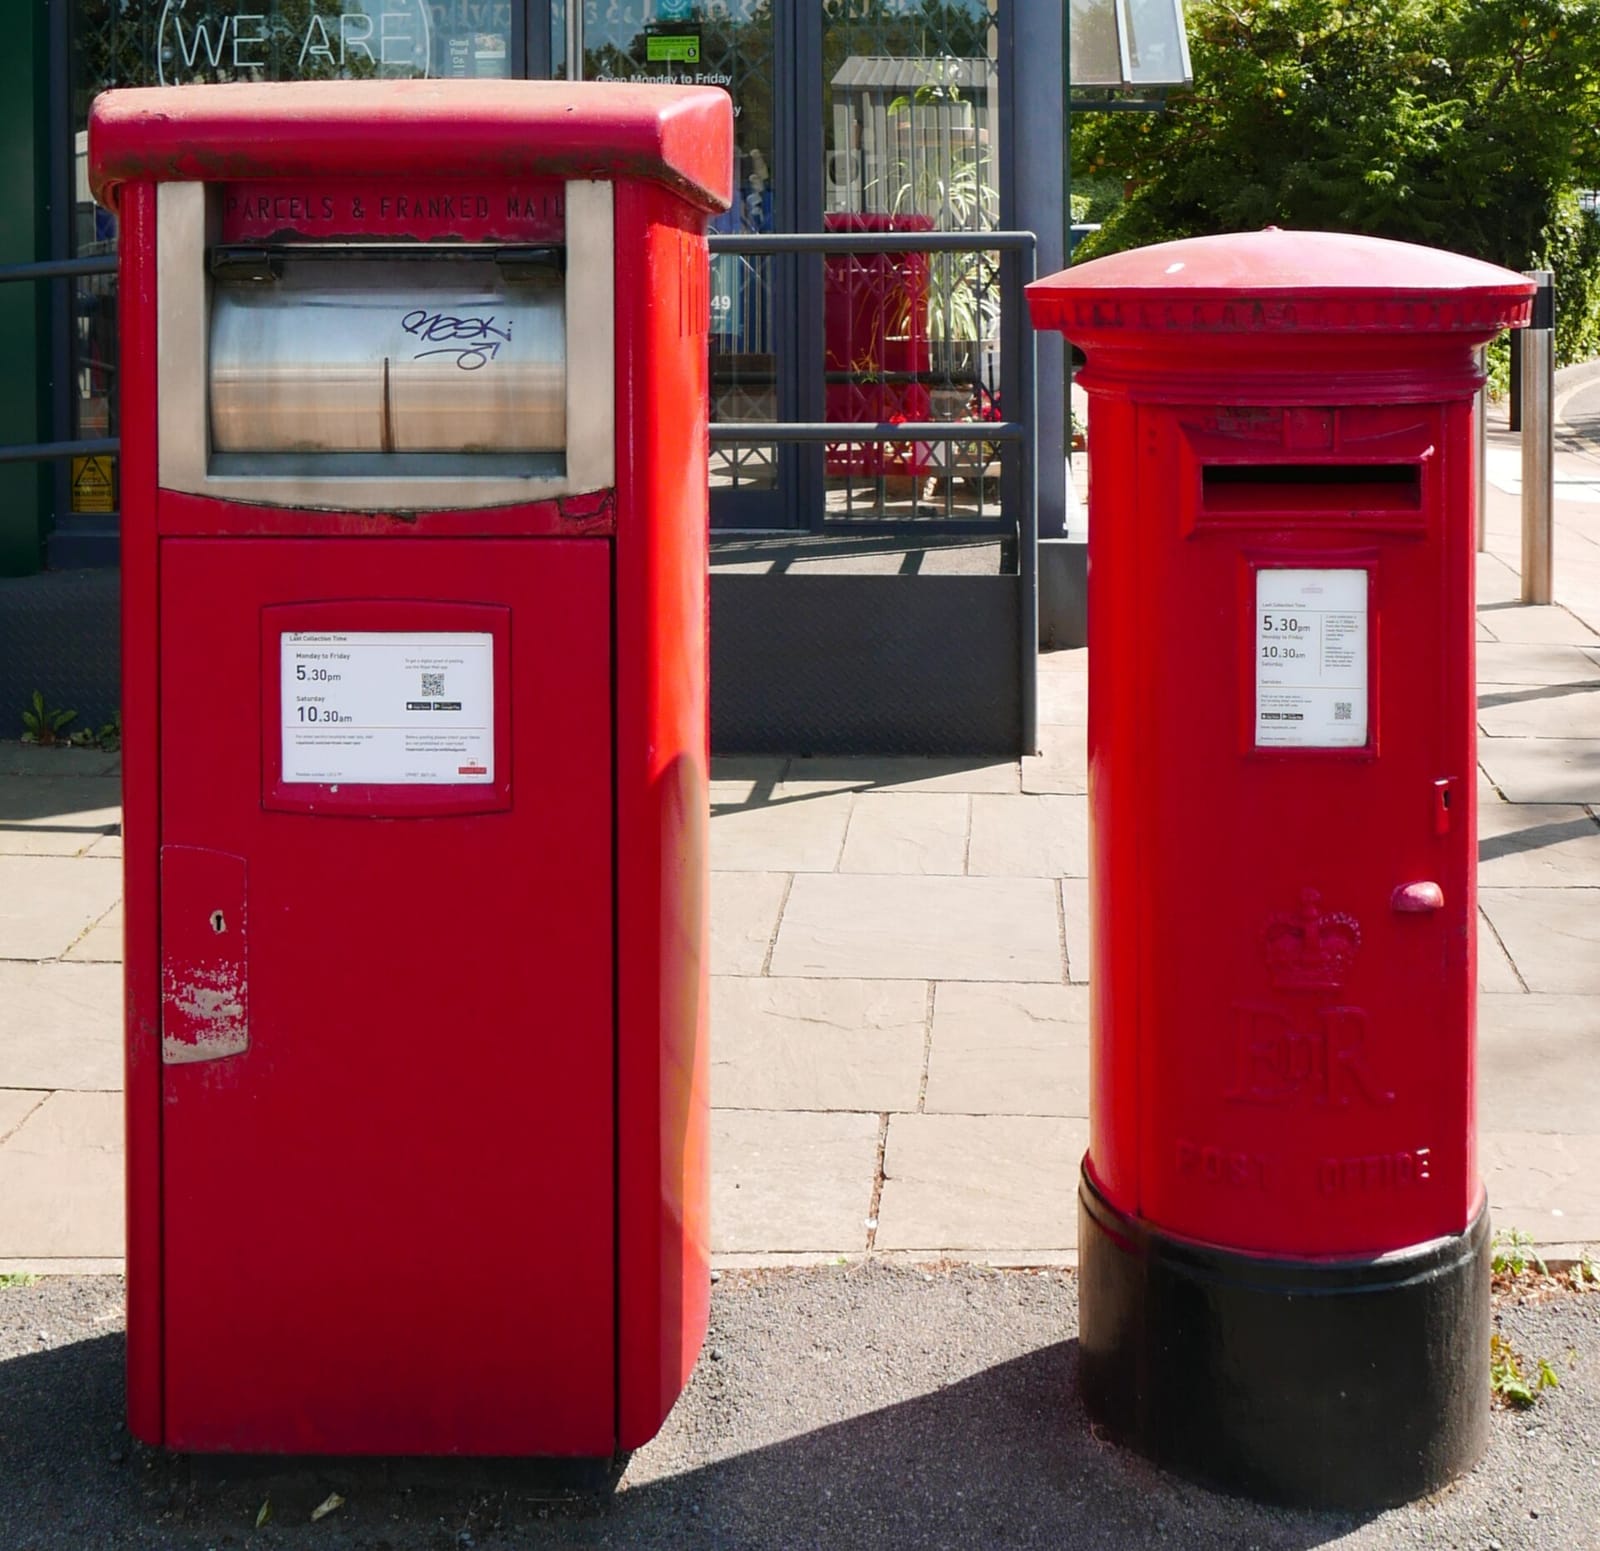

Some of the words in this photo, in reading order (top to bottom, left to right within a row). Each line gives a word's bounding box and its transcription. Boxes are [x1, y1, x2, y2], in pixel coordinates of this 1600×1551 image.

[175, 15, 264, 67] WE
[299, 14, 411, 65] ARE
[630, 74, 678, 85] Monday
[680, 74, 693, 84] to
[695, 73, 733, 86] Friday
[225, 197, 333, 219] PARCELS
[352, 197, 365, 219] &
[380, 196, 489, 219] FRANKED
[507, 195, 566, 219] MAIL
[1263, 615, 1311, 632] 5.30pm
[330, 652, 351, 660] Friday
[296, 664, 341, 682] 5.30pm
[297, 706, 352, 723] 10.30am
